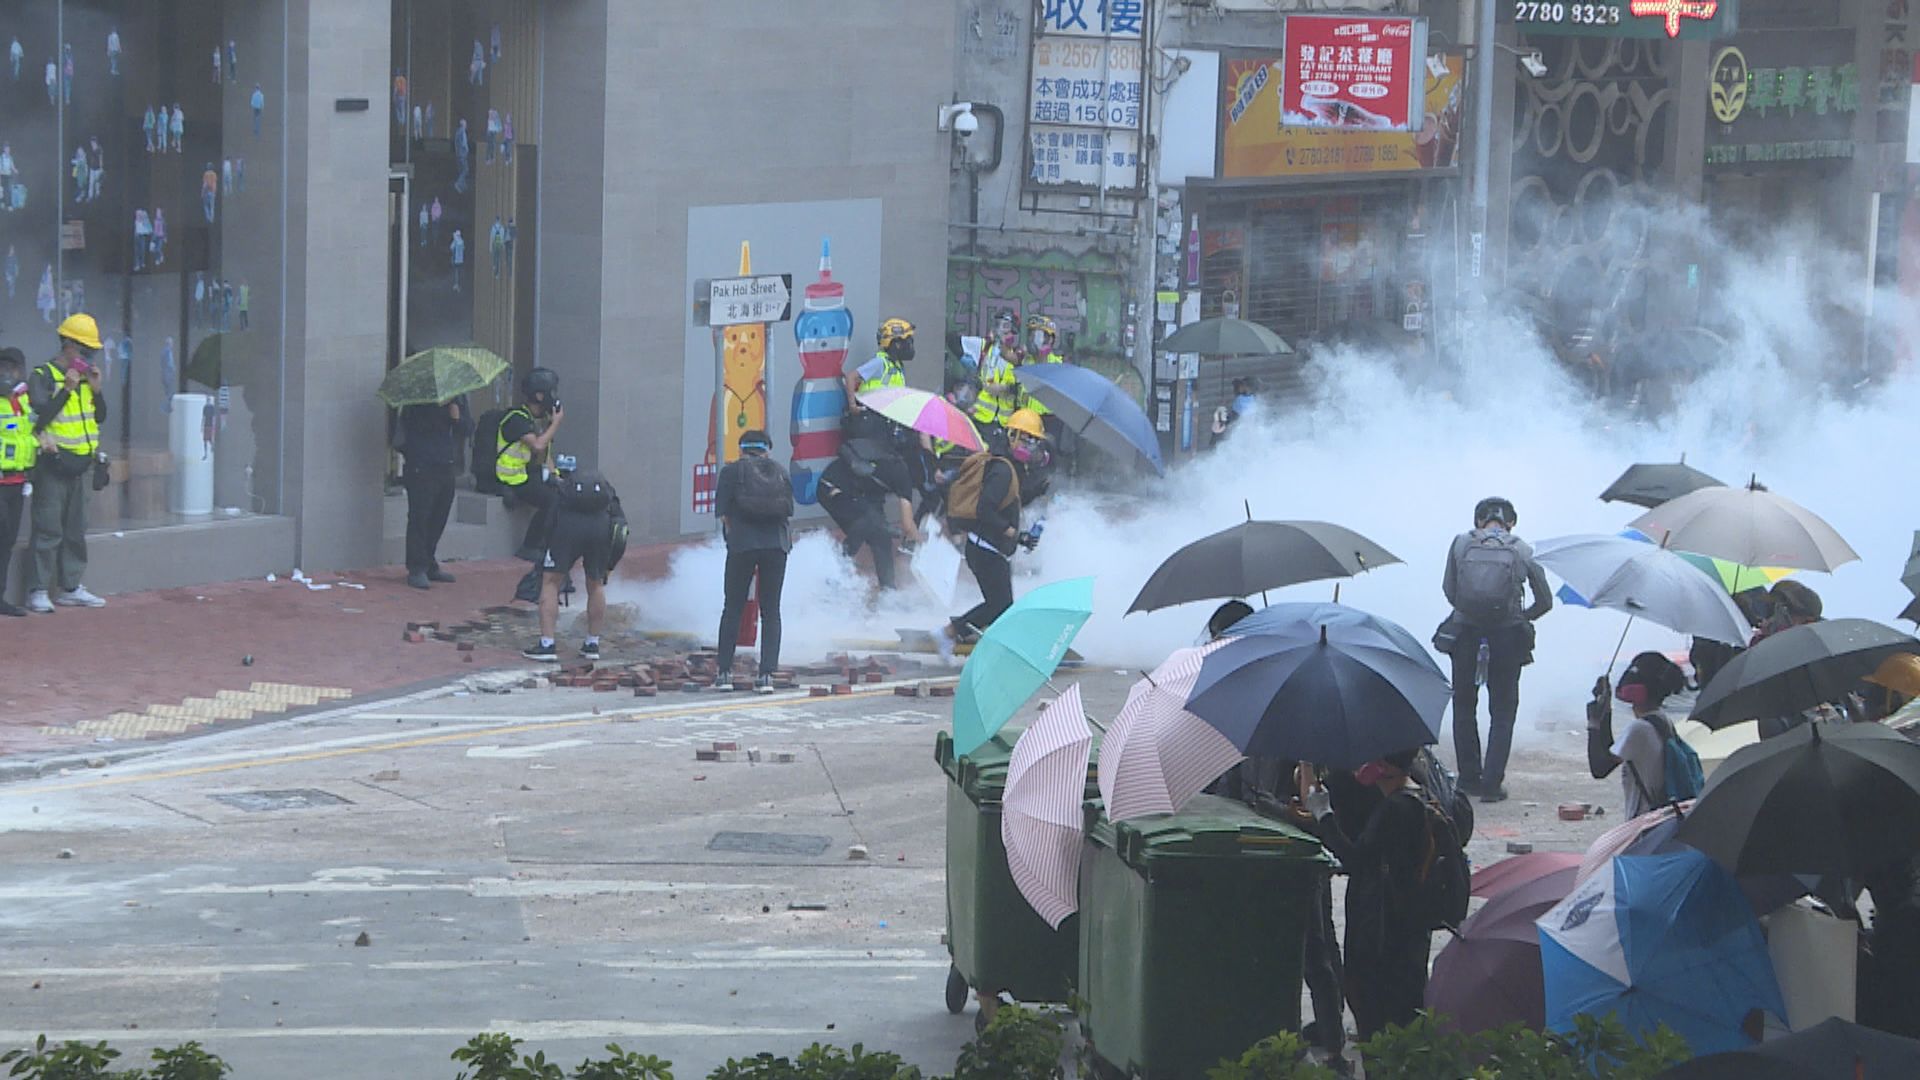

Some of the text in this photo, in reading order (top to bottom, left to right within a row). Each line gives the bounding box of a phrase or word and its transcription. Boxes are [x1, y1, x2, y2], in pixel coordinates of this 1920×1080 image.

[1515, 2, 1564, 22] 2780
[1571, 5, 1620, 24] 8328
[1300, 44, 1393, 65] 發記茶餐廳
[1300, 62, 1392, 73] FAT KEE RESTAURANT
[1718, 66, 1740, 82] TW
[1036, 77, 1140, 102] 本會成功處理
[713, 281, 777, 298] Pak Hoi Street
[727, 302, 762, 319] 北海街
